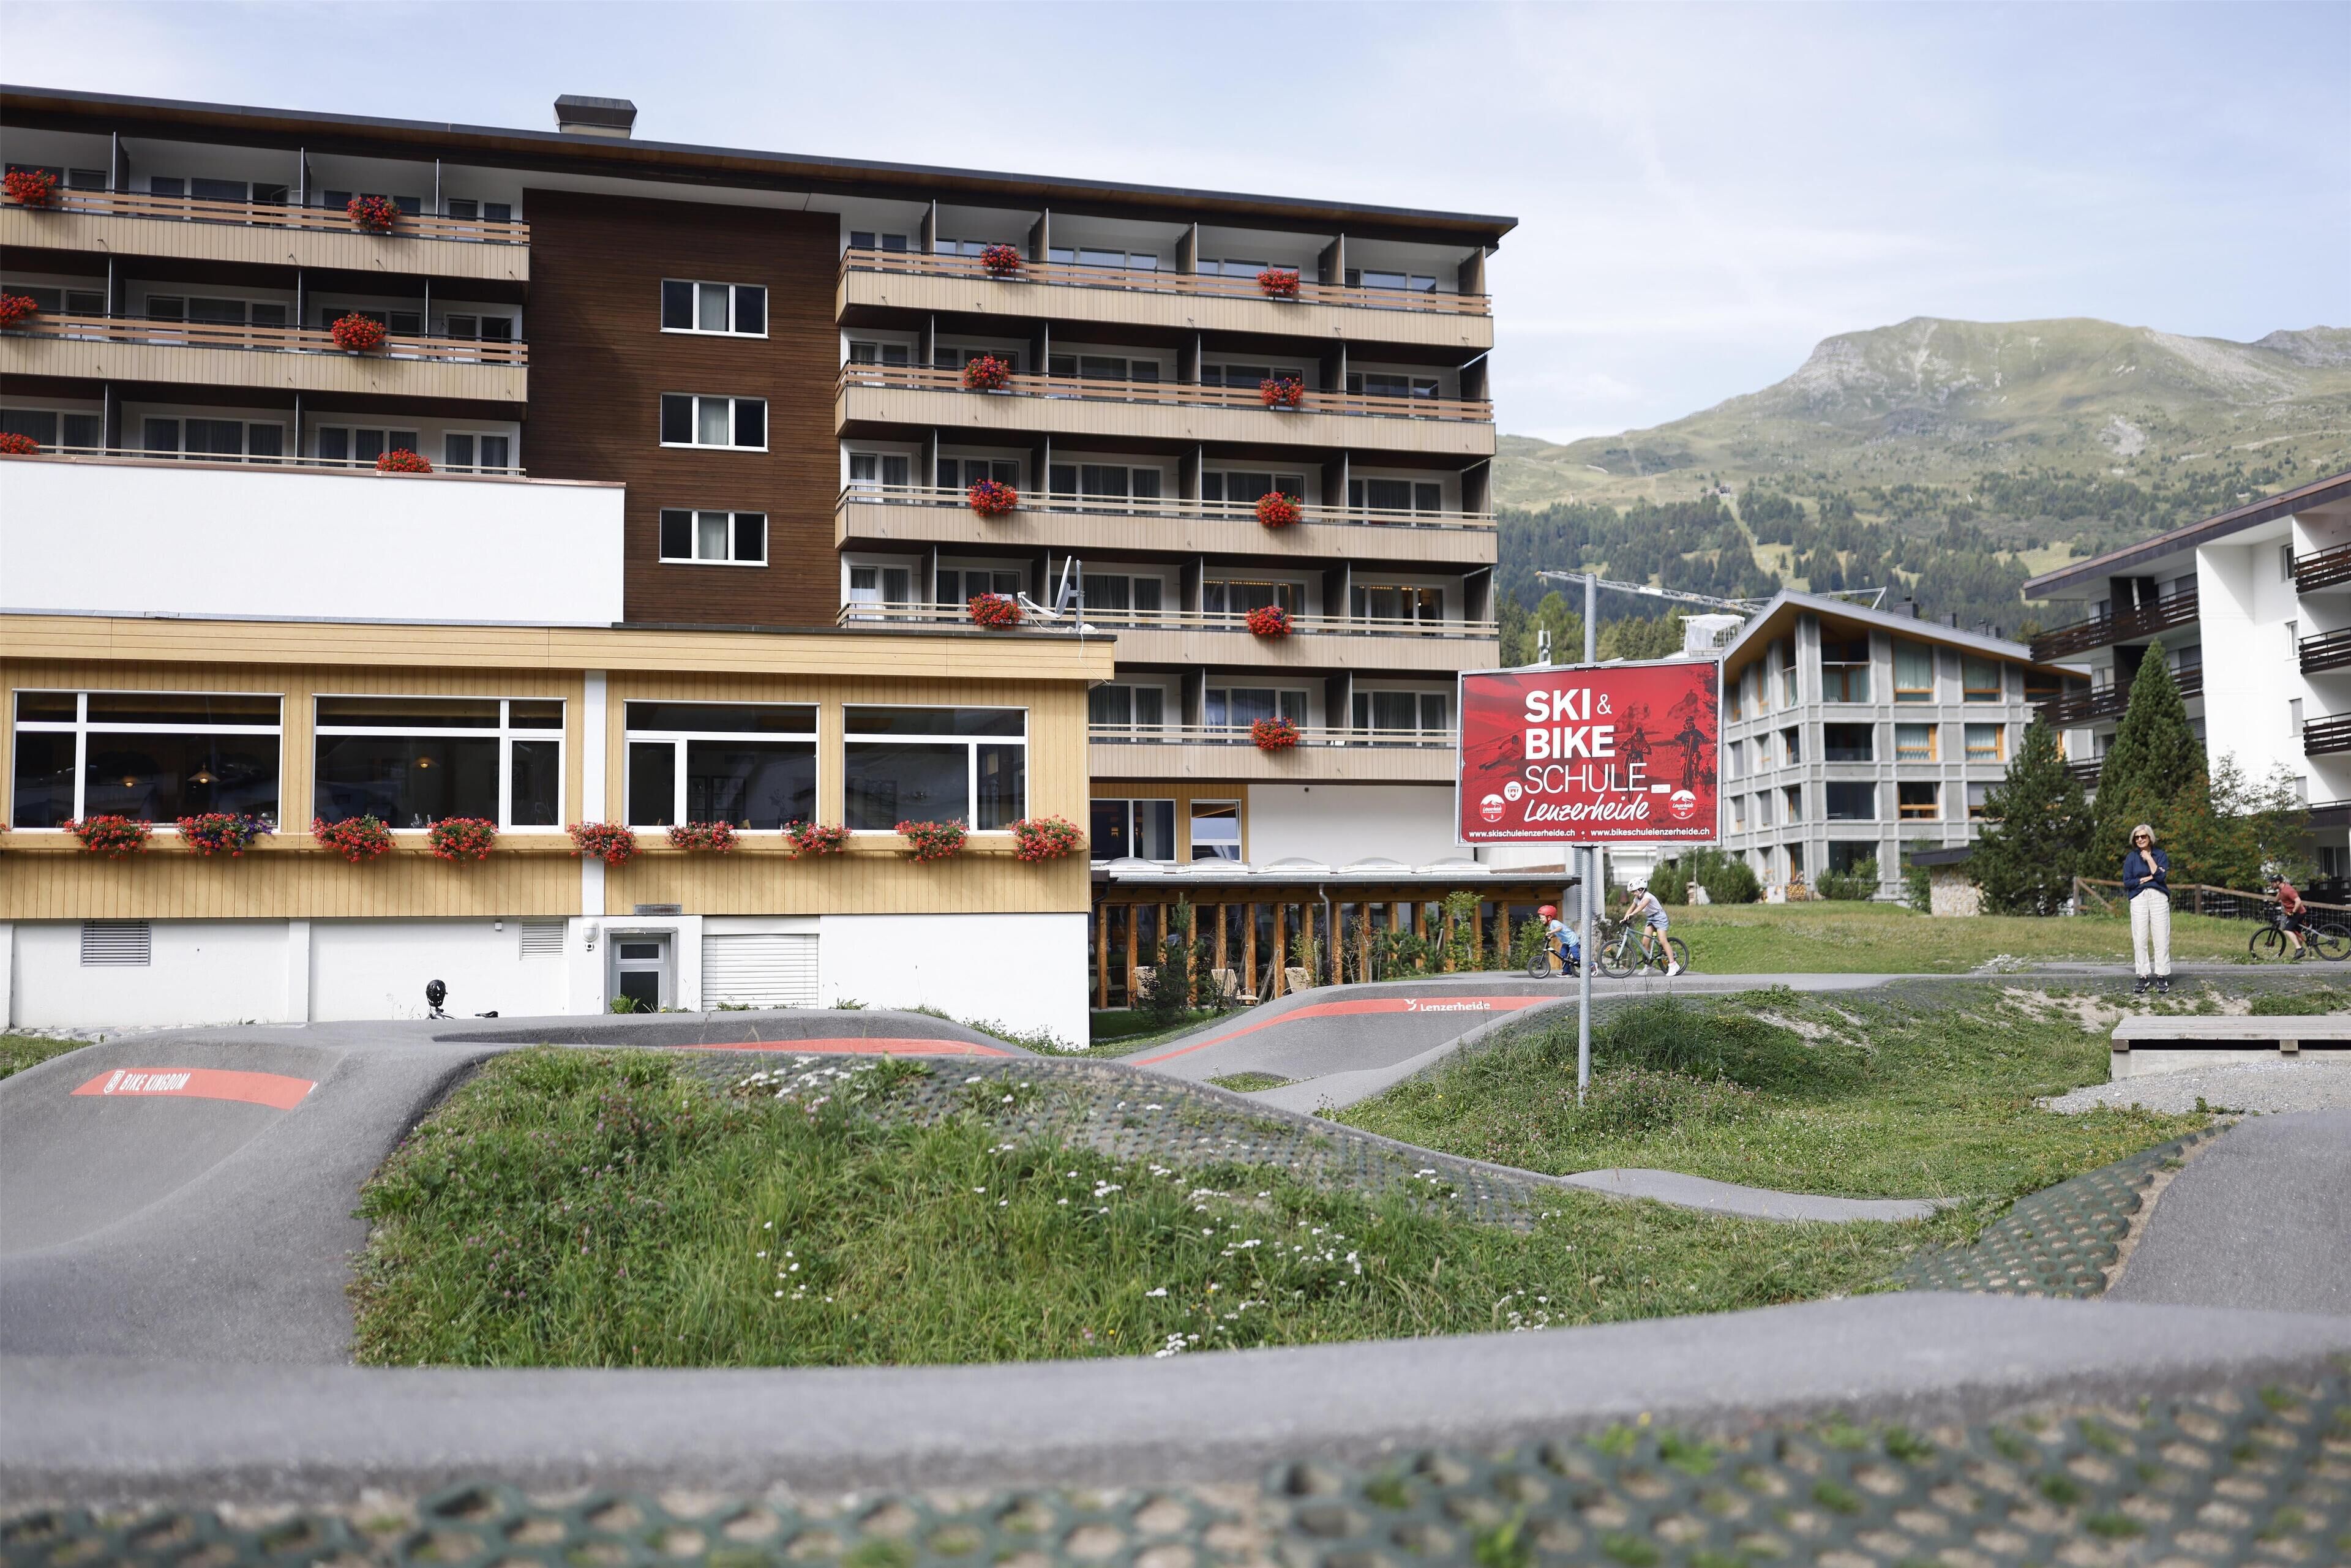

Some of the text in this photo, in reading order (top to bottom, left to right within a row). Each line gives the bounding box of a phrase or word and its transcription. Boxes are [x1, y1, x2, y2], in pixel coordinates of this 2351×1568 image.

[1524, 688, 1612, 723] SKI &
[1525, 725, 1615, 760] BIKE
[1524, 763, 1648, 794] SCHULE
[1524, 793, 1650, 822] Lenzerheide
[1469, 829, 1575, 838] www.skischulelenzerheide.ch
[1591, 827, 1710, 836] www.bikeschulelenzerheide.ch
[1420, 1001, 1491, 1012] Lenzerheide
[119, 1073, 191, 1091] BIKE KINGDOM
